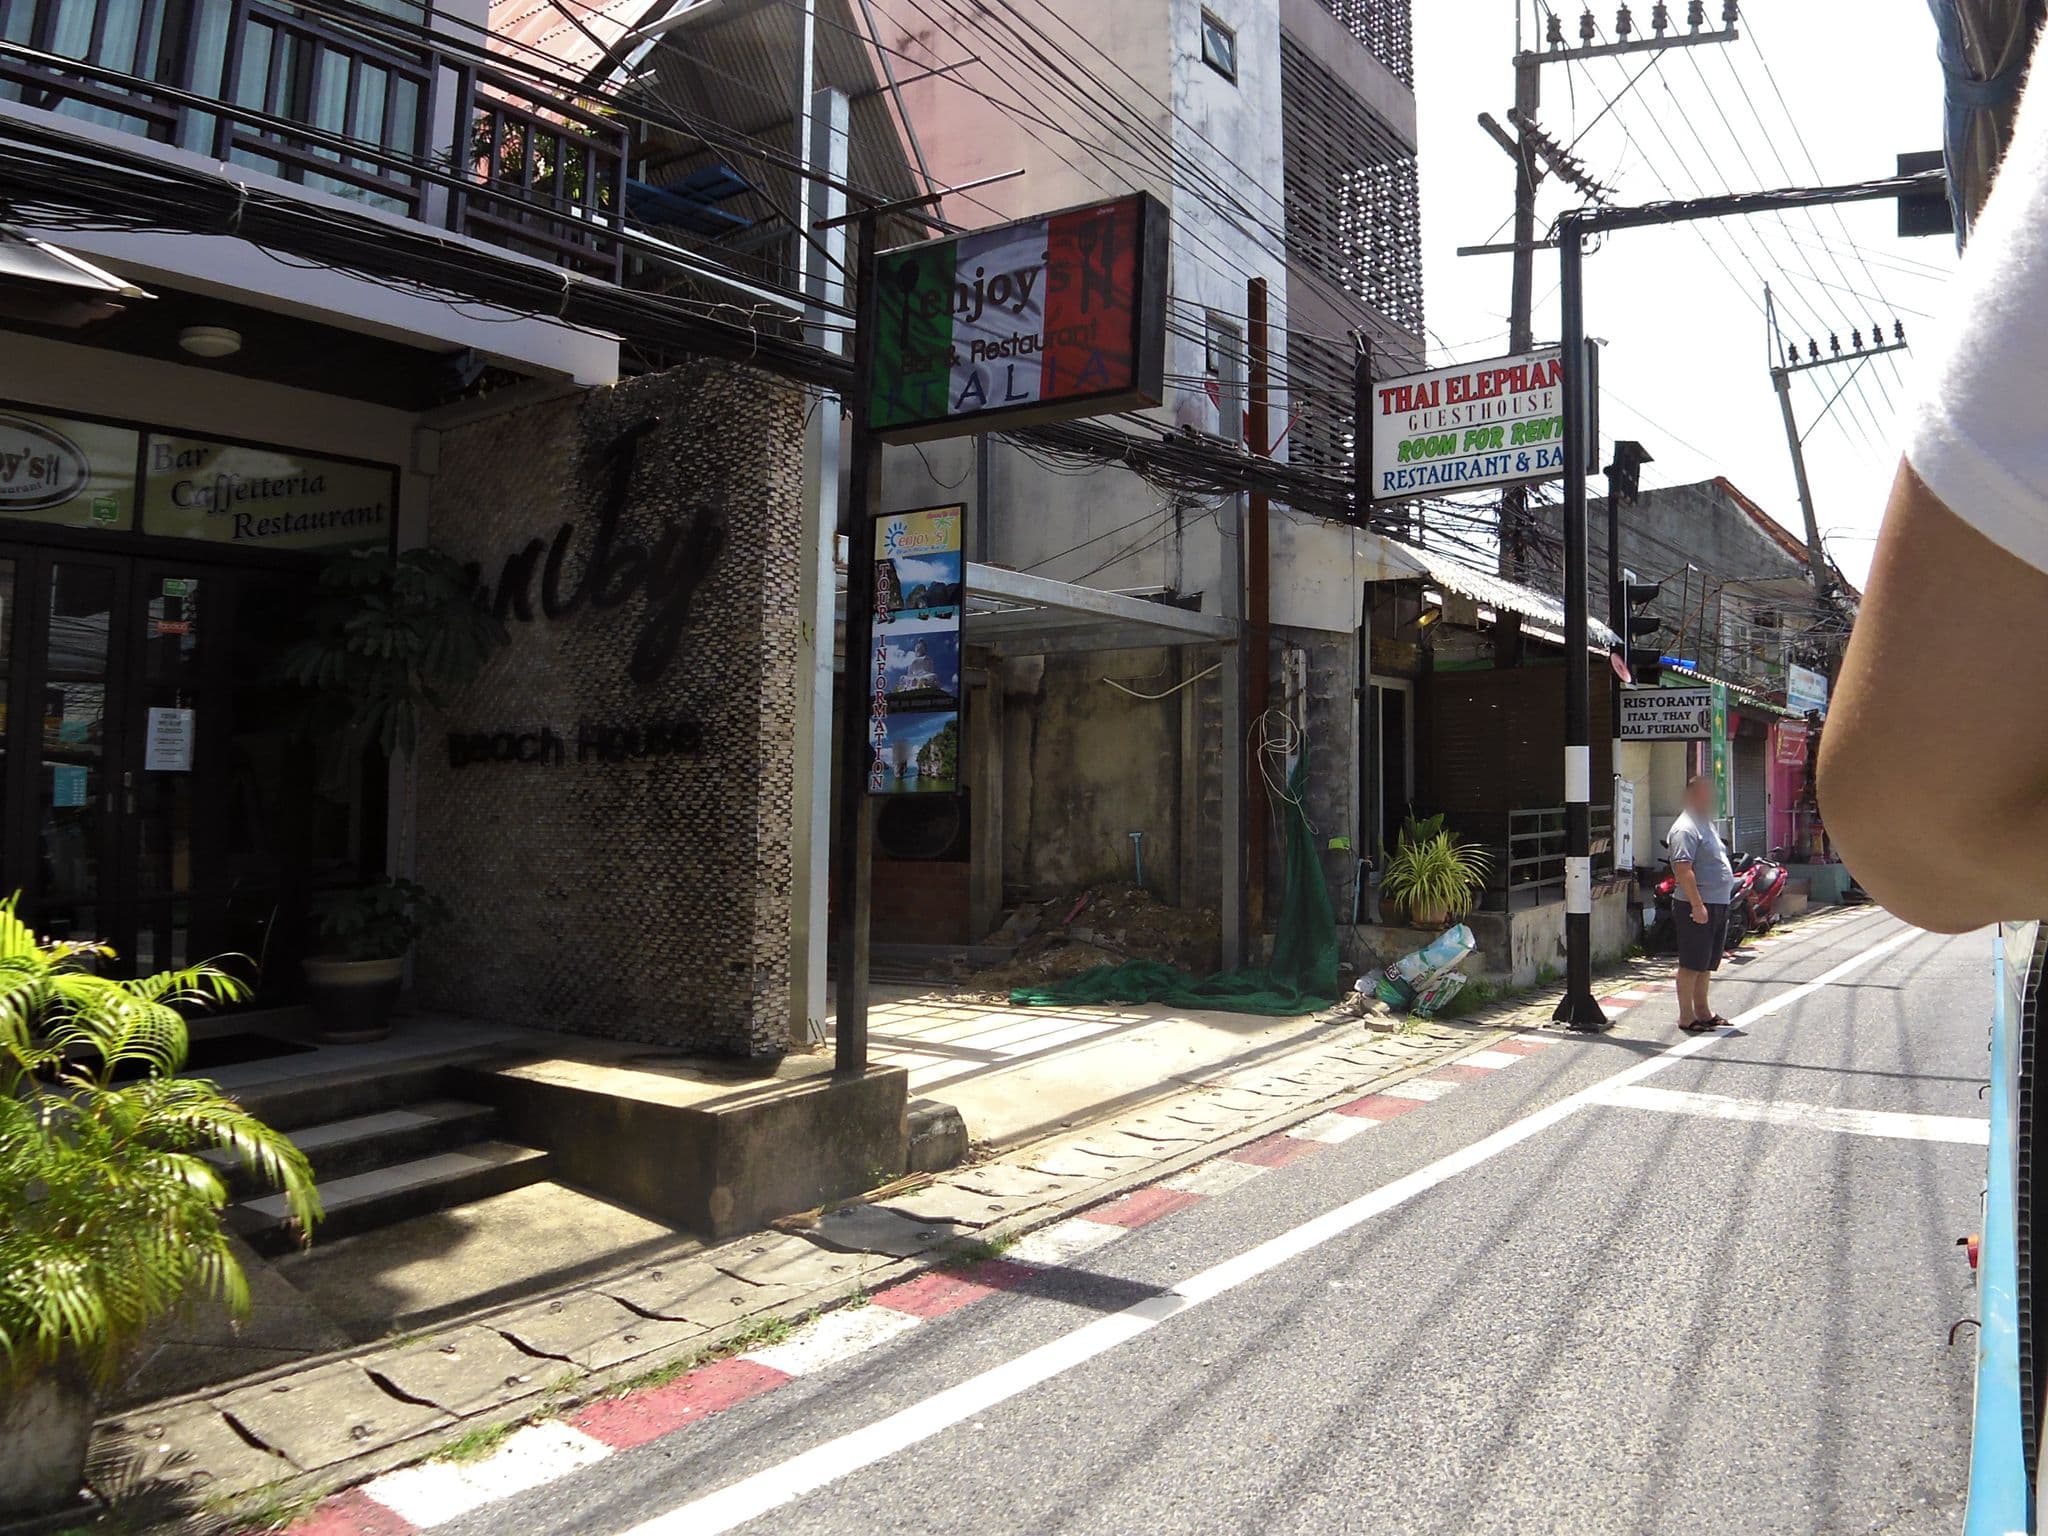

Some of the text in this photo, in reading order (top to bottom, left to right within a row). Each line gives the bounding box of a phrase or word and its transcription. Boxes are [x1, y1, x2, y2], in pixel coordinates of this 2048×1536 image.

[919, 251, 1071, 323] enjoy's
[946, 346, 961, 367] &
[971, 320, 1097, 364] Restaurant
[886, 350, 1111, 418] ITALIA
[1379, 359, 1563, 415] THAI ELEPHAN
[1409, 391, 1553, 431] GUESTHOUSE
[153, 442, 208, 472] Bar
[1398, 415, 1564, 463] ROOM FOR RENT
[1383, 446, 1563, 491] RESTAURANT & BA
[172, 472, 326, 516] Caffetteria
[232, 501, 384, 540] Restaurant
[877, 562, 890, 621] TOUR
[871, 635, 888, 790] INFORMATION
[1622, 724, 1699, 735] DAL FURIANO
